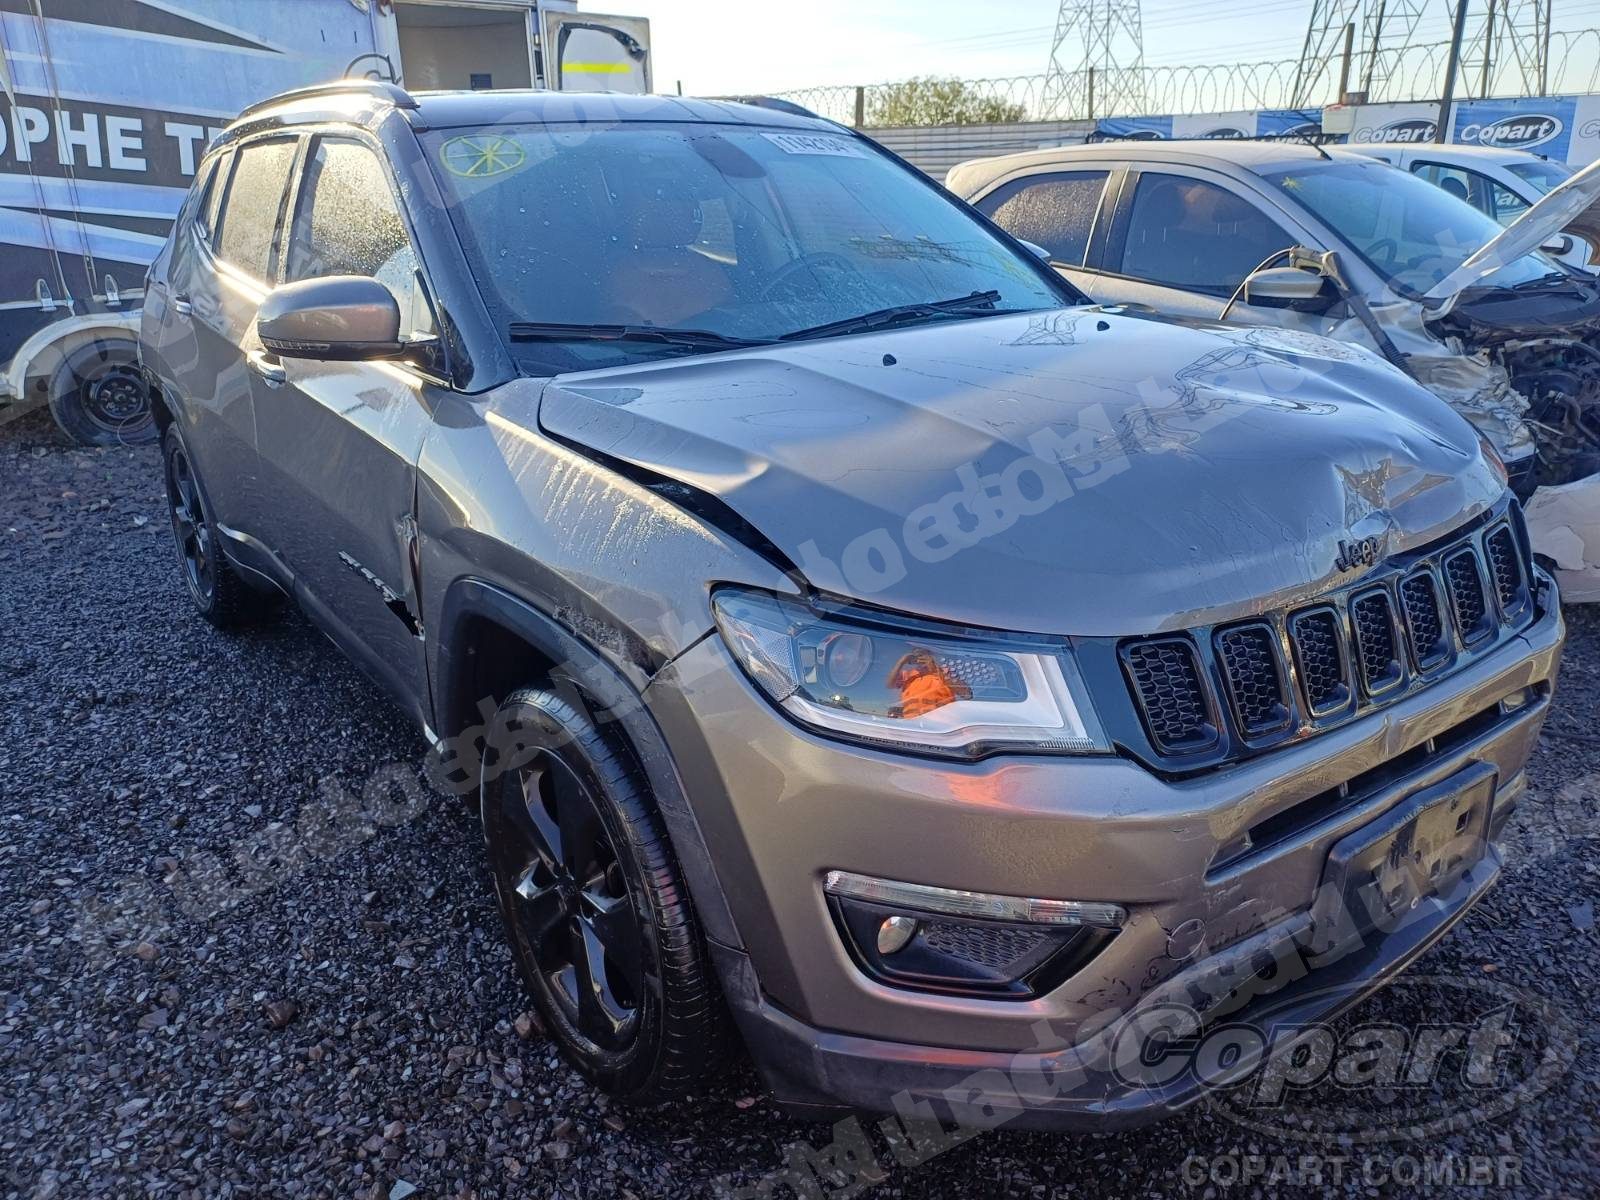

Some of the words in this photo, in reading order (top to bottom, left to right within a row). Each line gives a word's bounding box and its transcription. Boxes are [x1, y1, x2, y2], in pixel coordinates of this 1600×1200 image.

[0, 105, 147, 172] PHE
[1355, 124, 1437, 145] Copart
[1461, 119, 1553, 147] Copart
[1334, 536, 1378, 573] Jeep
